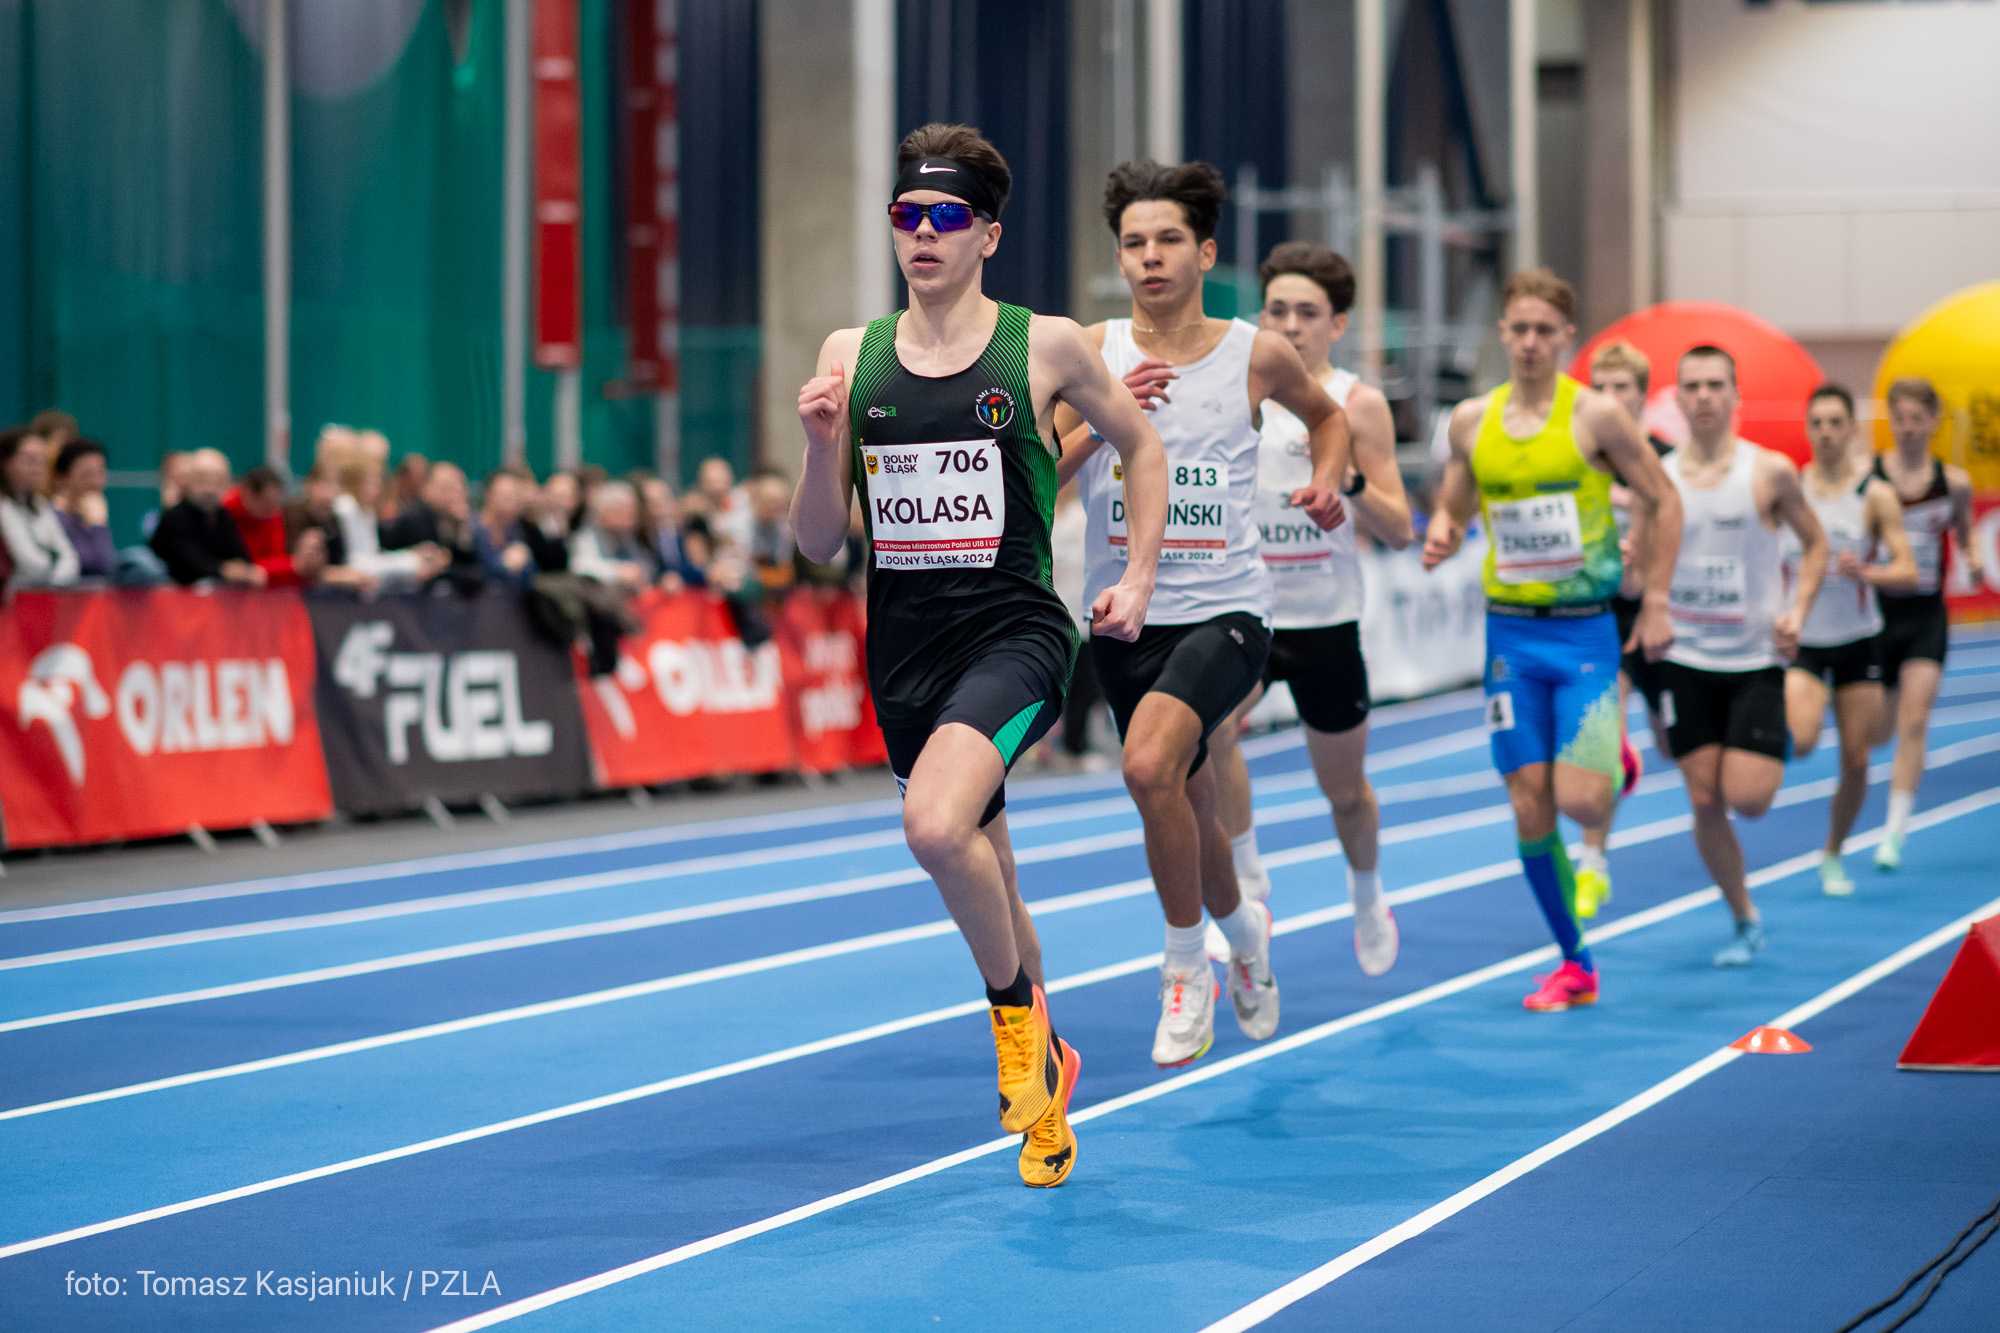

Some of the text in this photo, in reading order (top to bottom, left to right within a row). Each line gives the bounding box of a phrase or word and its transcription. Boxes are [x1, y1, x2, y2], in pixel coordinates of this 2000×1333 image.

[975, 390, 990, 405] AML
[883, 448, 989, 474] DOLNY 706
[884, 463, 918, 475] ŚLĄSK
[1175, 466, 1217, 486] 813
[876, 494, 993, 524] KOLASA
[1112, 499, 1222, 526] DIŃSKI
[911, 542, 950, 550] Mistrzostwa
[951, 540, 971, 549] Polski
[972, 539, 984, 548] U18
[885, 553, 993, 566] DOLNY ŚLĄSK 2024
[1159, 552, 1213, 561] LĄSK 2024
[333, 620, 394, 698] 4F
[116, 658, 294, 756] ORLEN
[384, 650, 553, 765] FUEL
